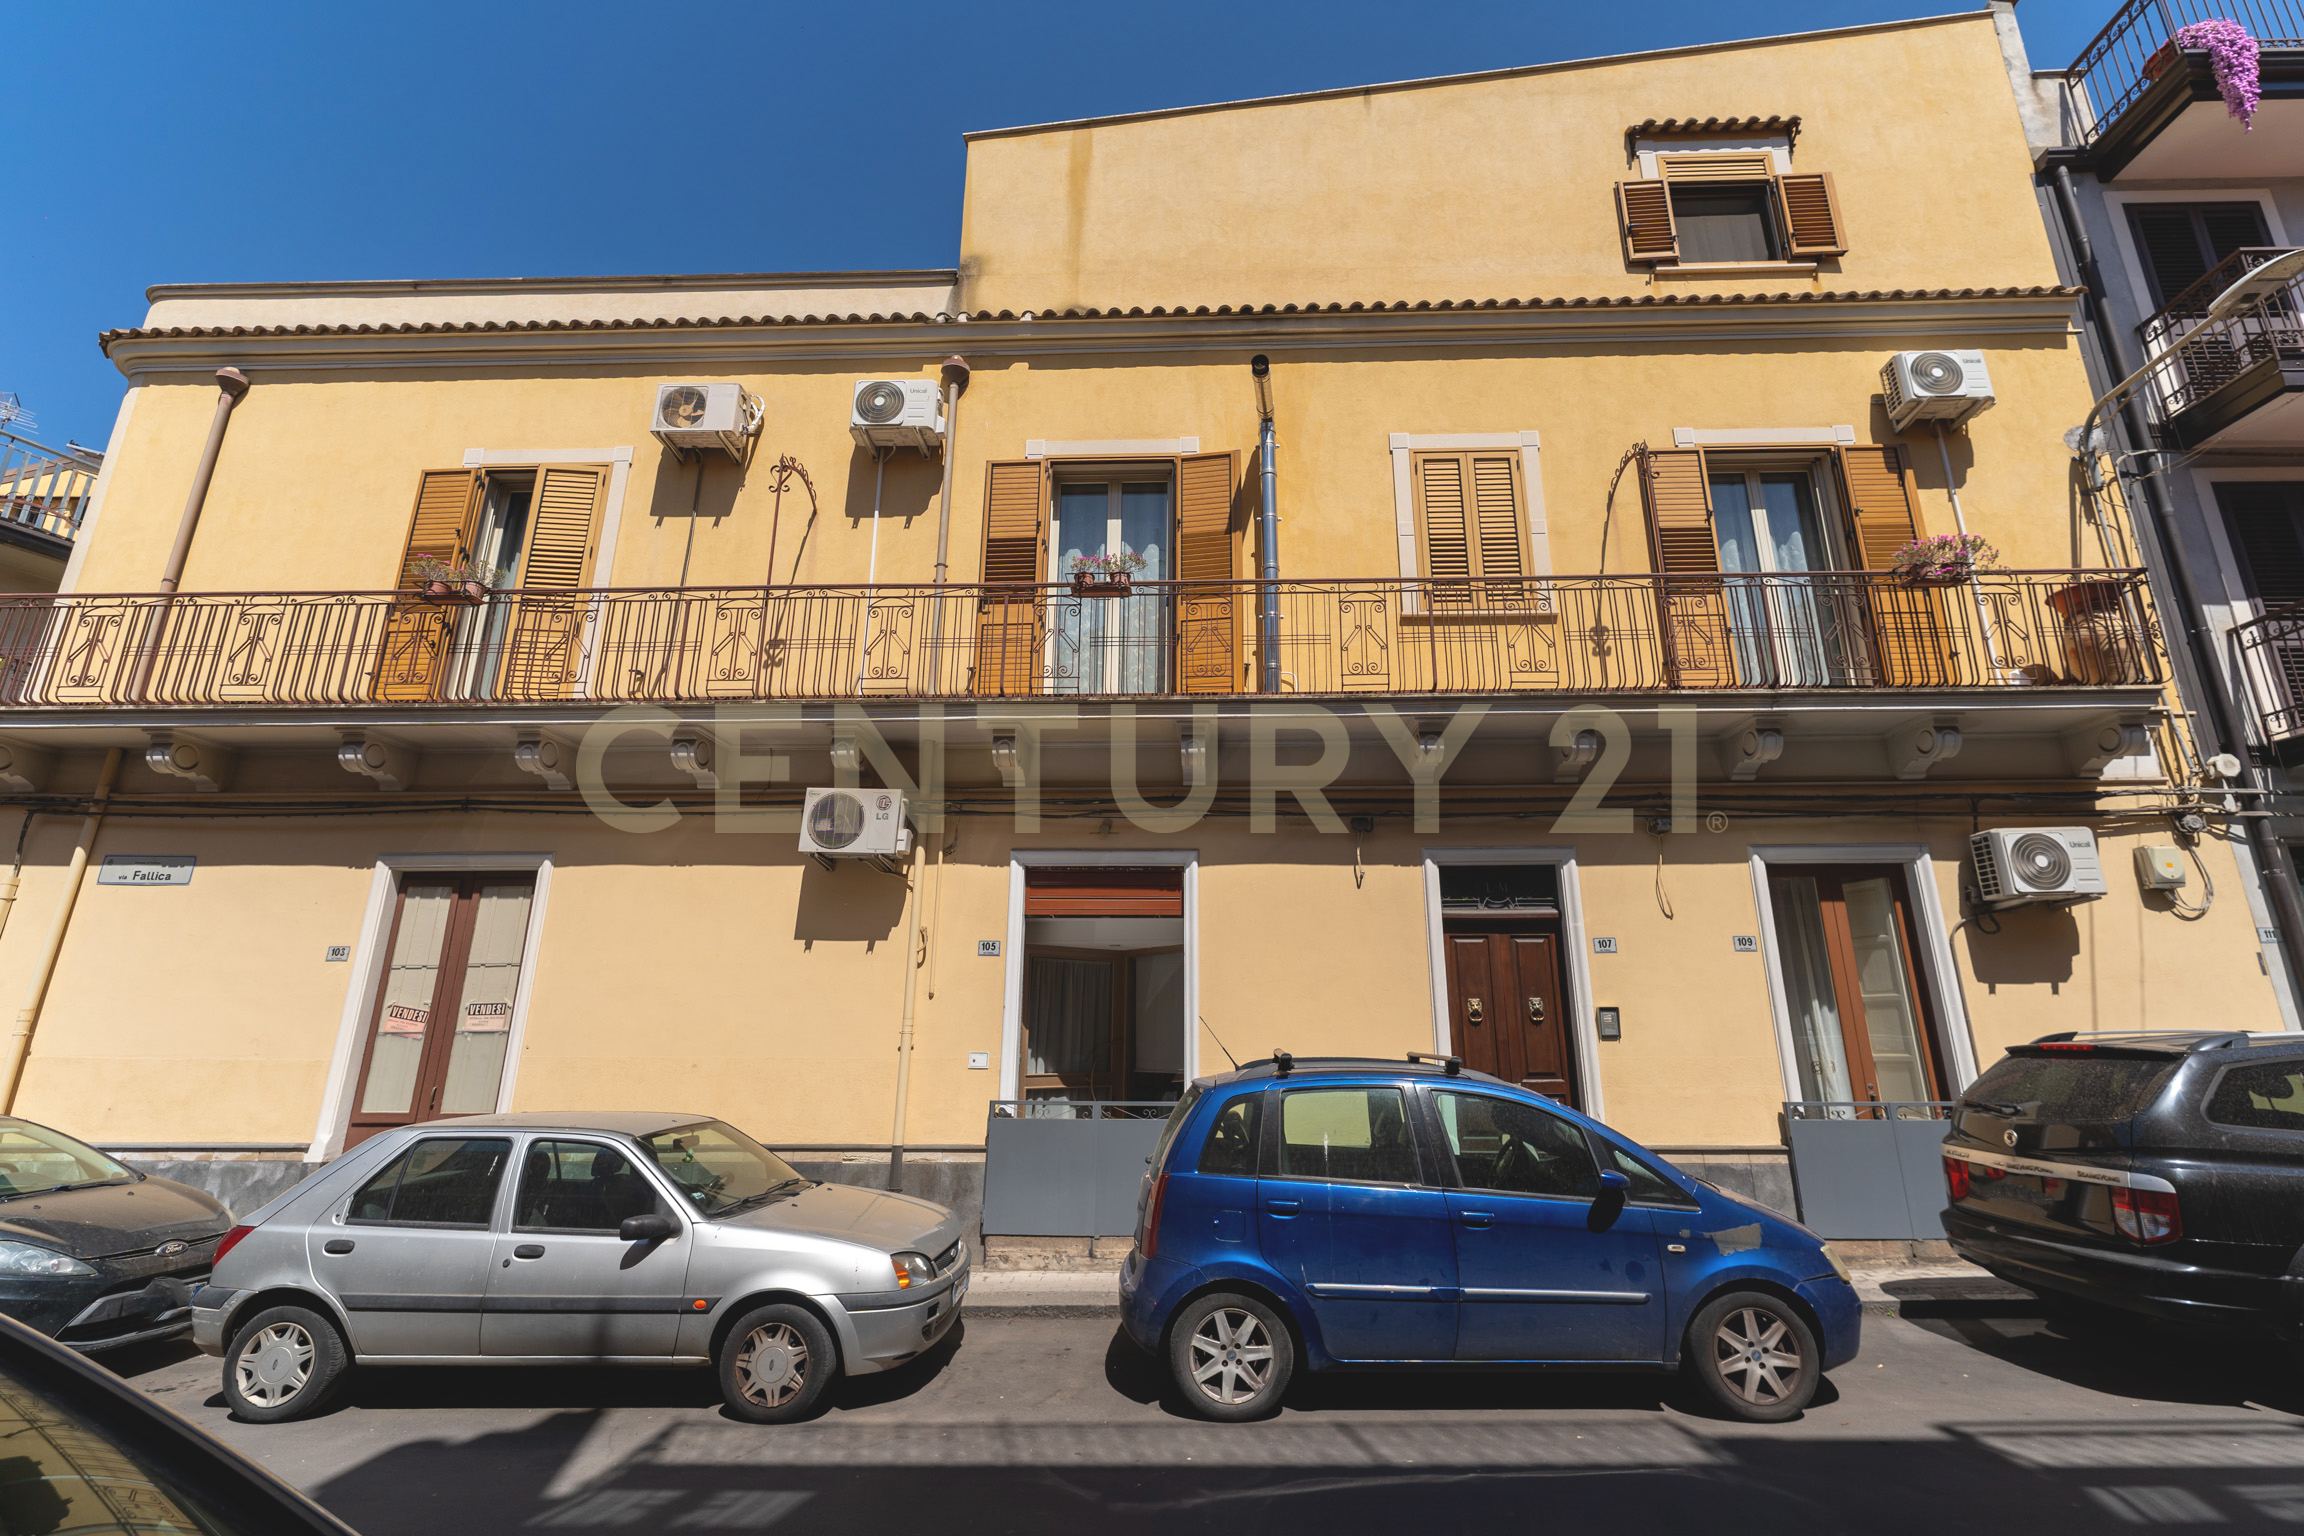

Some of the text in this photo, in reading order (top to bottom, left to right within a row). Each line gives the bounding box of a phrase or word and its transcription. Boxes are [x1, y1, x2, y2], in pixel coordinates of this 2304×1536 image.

[875, 812, 889, 821] LG
[132, 870, 172, 881] Fallica
[2264, 929, 2276, 939] 111
[981, 942, 997, 951] 105
[1597, 939, 1612, 949] 107
[1737, 937, 1753, 946] 109
[331, 947, 346, 957] 103
[470, 1003, 506, 1015] VENDESI
[391, 1006, 428, 1023] VENDESI
[165, 1243, 183, 1254] Ford
